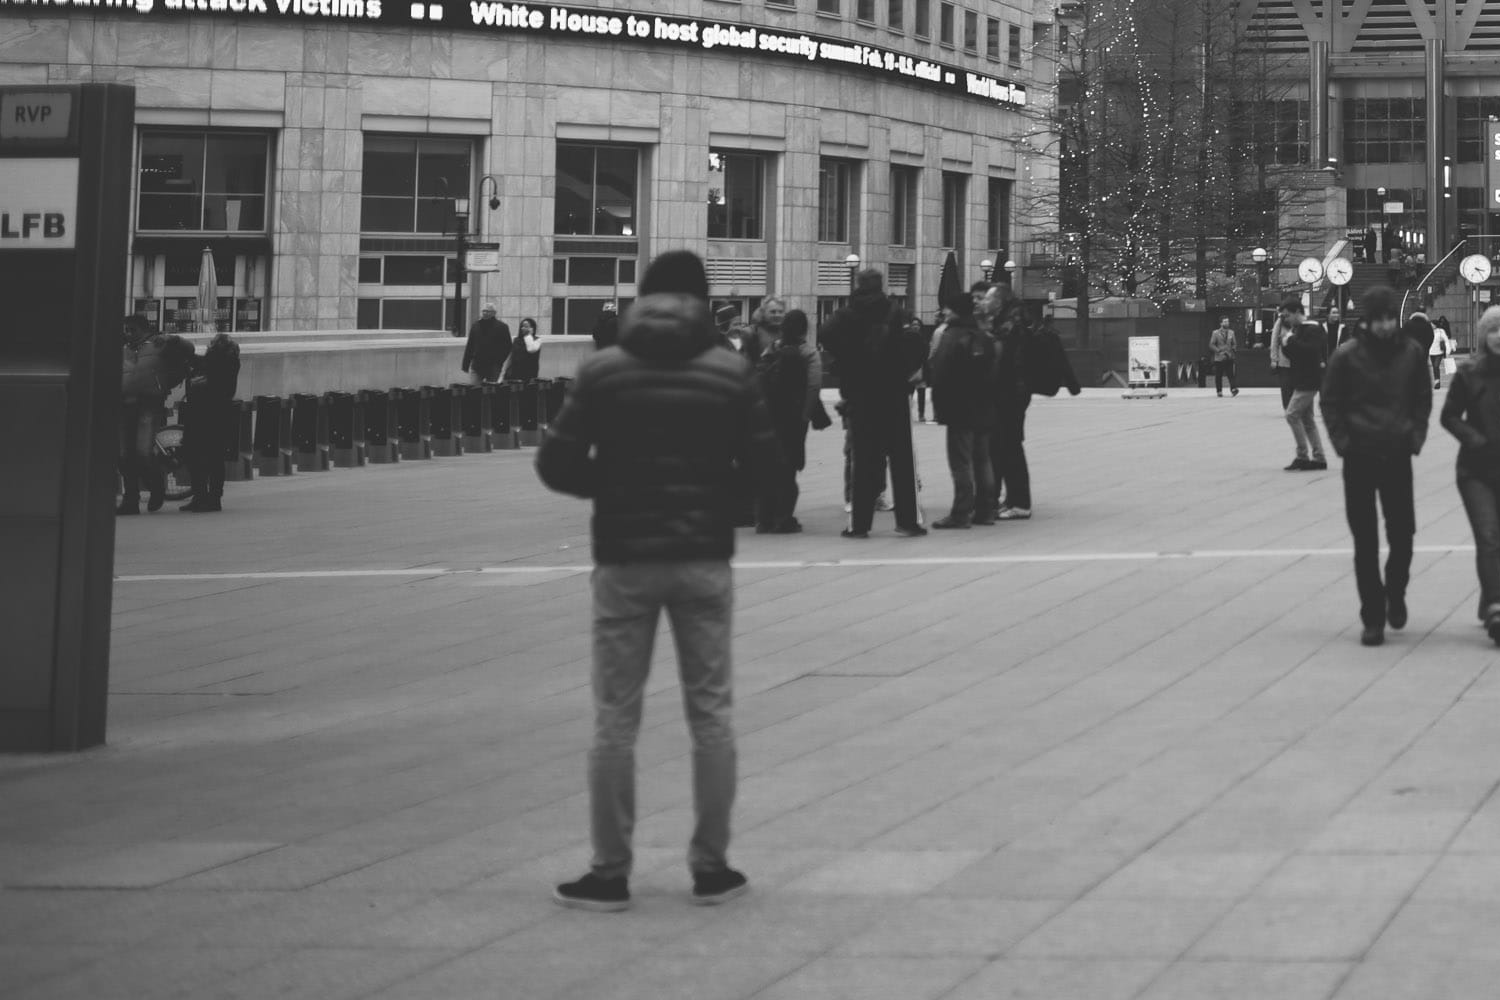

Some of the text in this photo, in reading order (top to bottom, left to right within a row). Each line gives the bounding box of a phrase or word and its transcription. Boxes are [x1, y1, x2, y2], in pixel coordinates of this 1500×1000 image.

[470, 1, 544, 28] White
[551, 8, 623, 35] House
[626, 15, 650, 37] to
[654, 17, 699, 42] host
[702, 24, 756, 48] global
[758, 34, 818, 60] security
[15, 105, 52, 122] RVP
[1, 213, 65, 238] LFB
